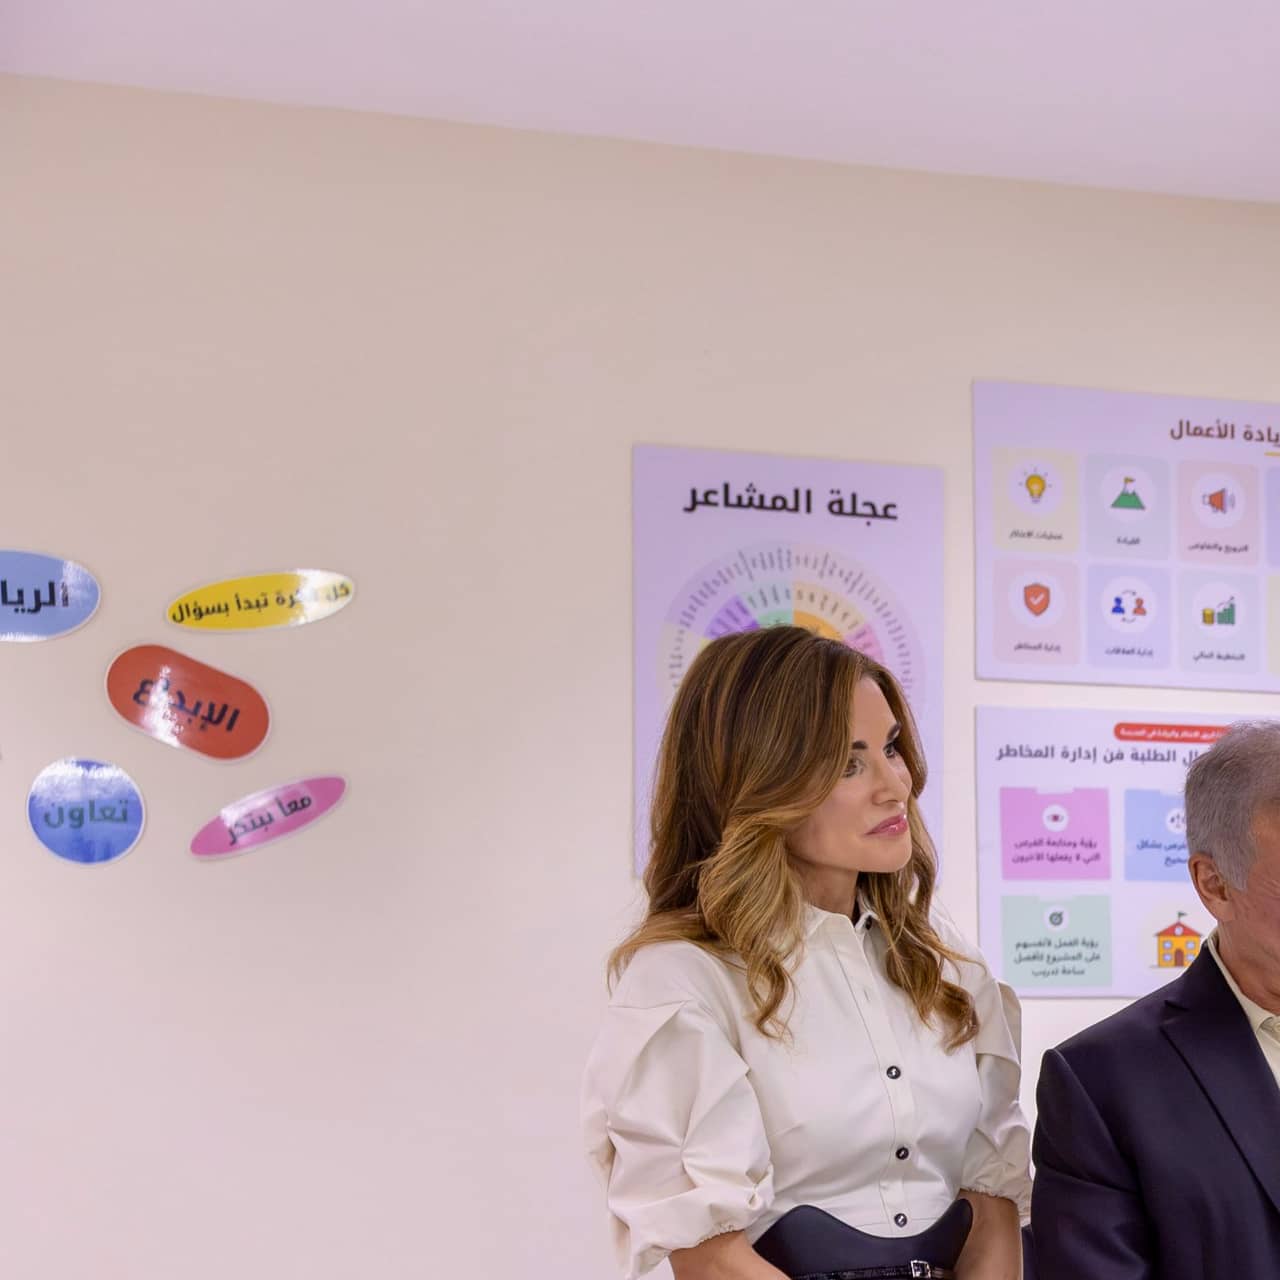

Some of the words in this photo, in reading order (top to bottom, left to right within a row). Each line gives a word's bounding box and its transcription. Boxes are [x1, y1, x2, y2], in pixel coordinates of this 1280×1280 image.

[1170, 418, 1235, 441] الأعمال
[683, 481, 812, 514] المشاعر
[827, 489, 898, 526] عجلة
[0, 578, 69, 614] الريا
[236, 592, 269, 613] تبدأ
[172, 598, 230, 623] بسؤال
[996, 743, 1055, 761] المخاطر
[1061, 745, 1098, 764] إدارة
[43, 798, 130, 830] تعاون
